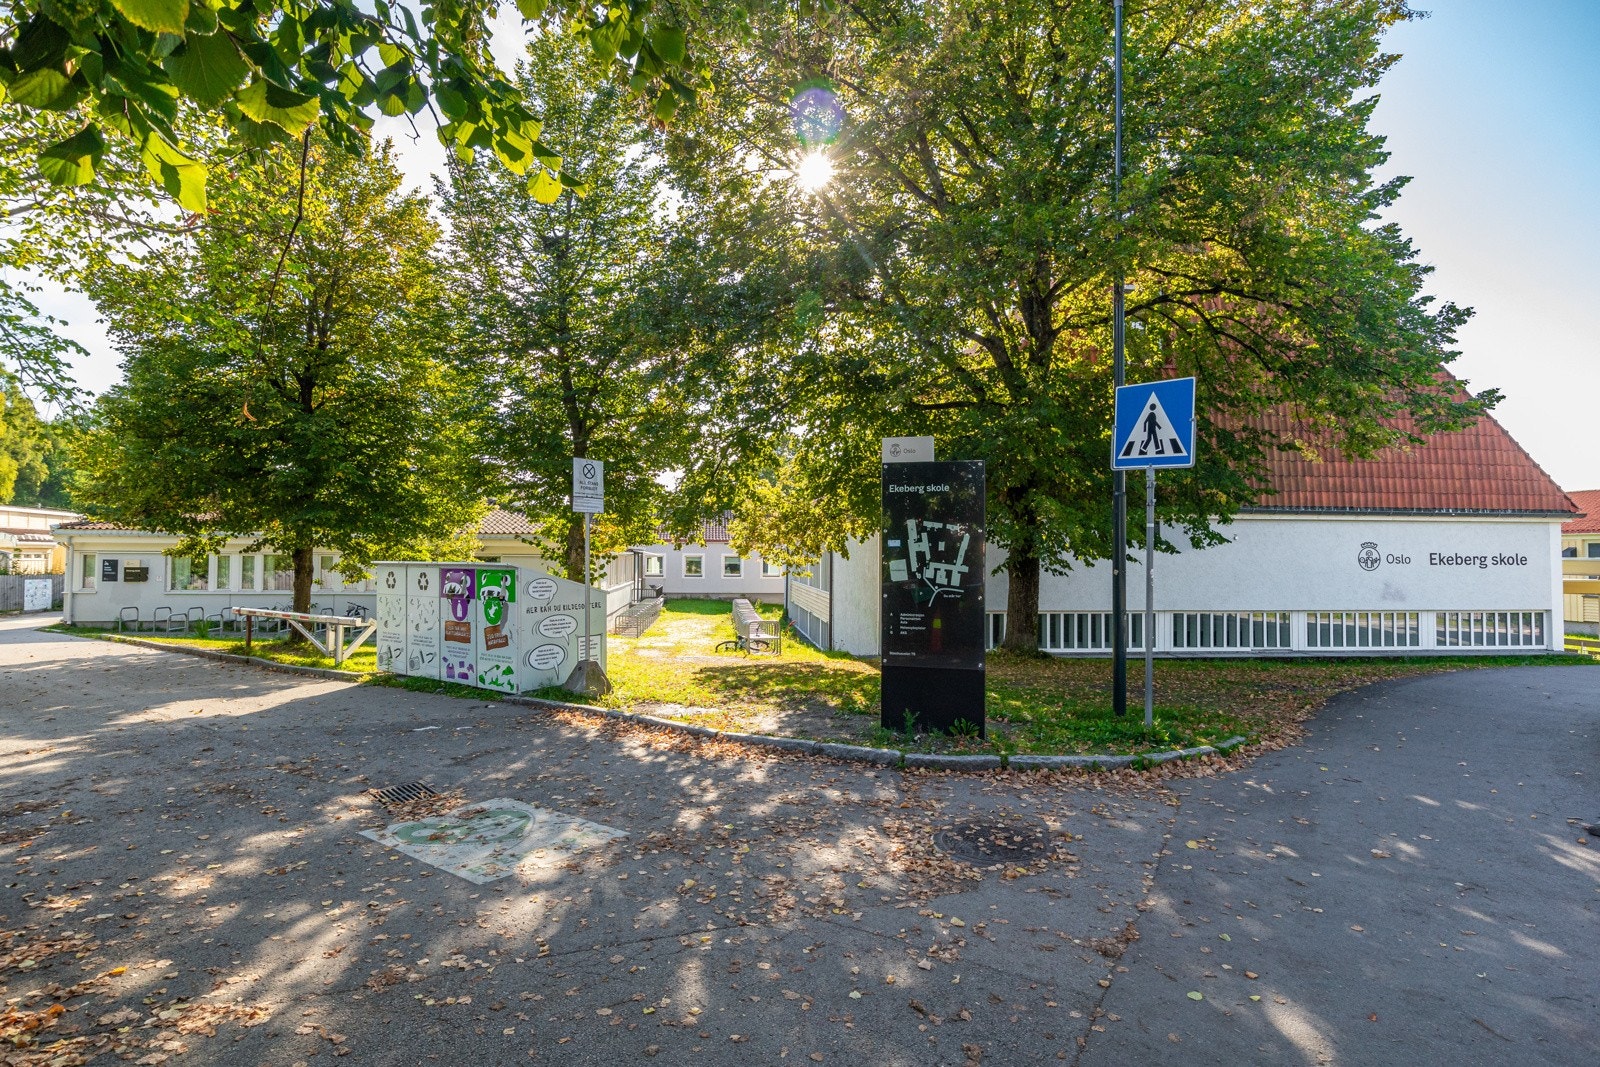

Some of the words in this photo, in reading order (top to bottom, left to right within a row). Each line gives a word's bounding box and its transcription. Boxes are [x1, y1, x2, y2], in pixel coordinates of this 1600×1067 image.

[889, 484, 925, 494] Ekeberg
[926, 484, 950, 492] skole
[1386, 554, 1411, 564] Oslo
[1429, 553, 1488, 569] Ekeberg
[1491, 553, 1528, 566] skole
